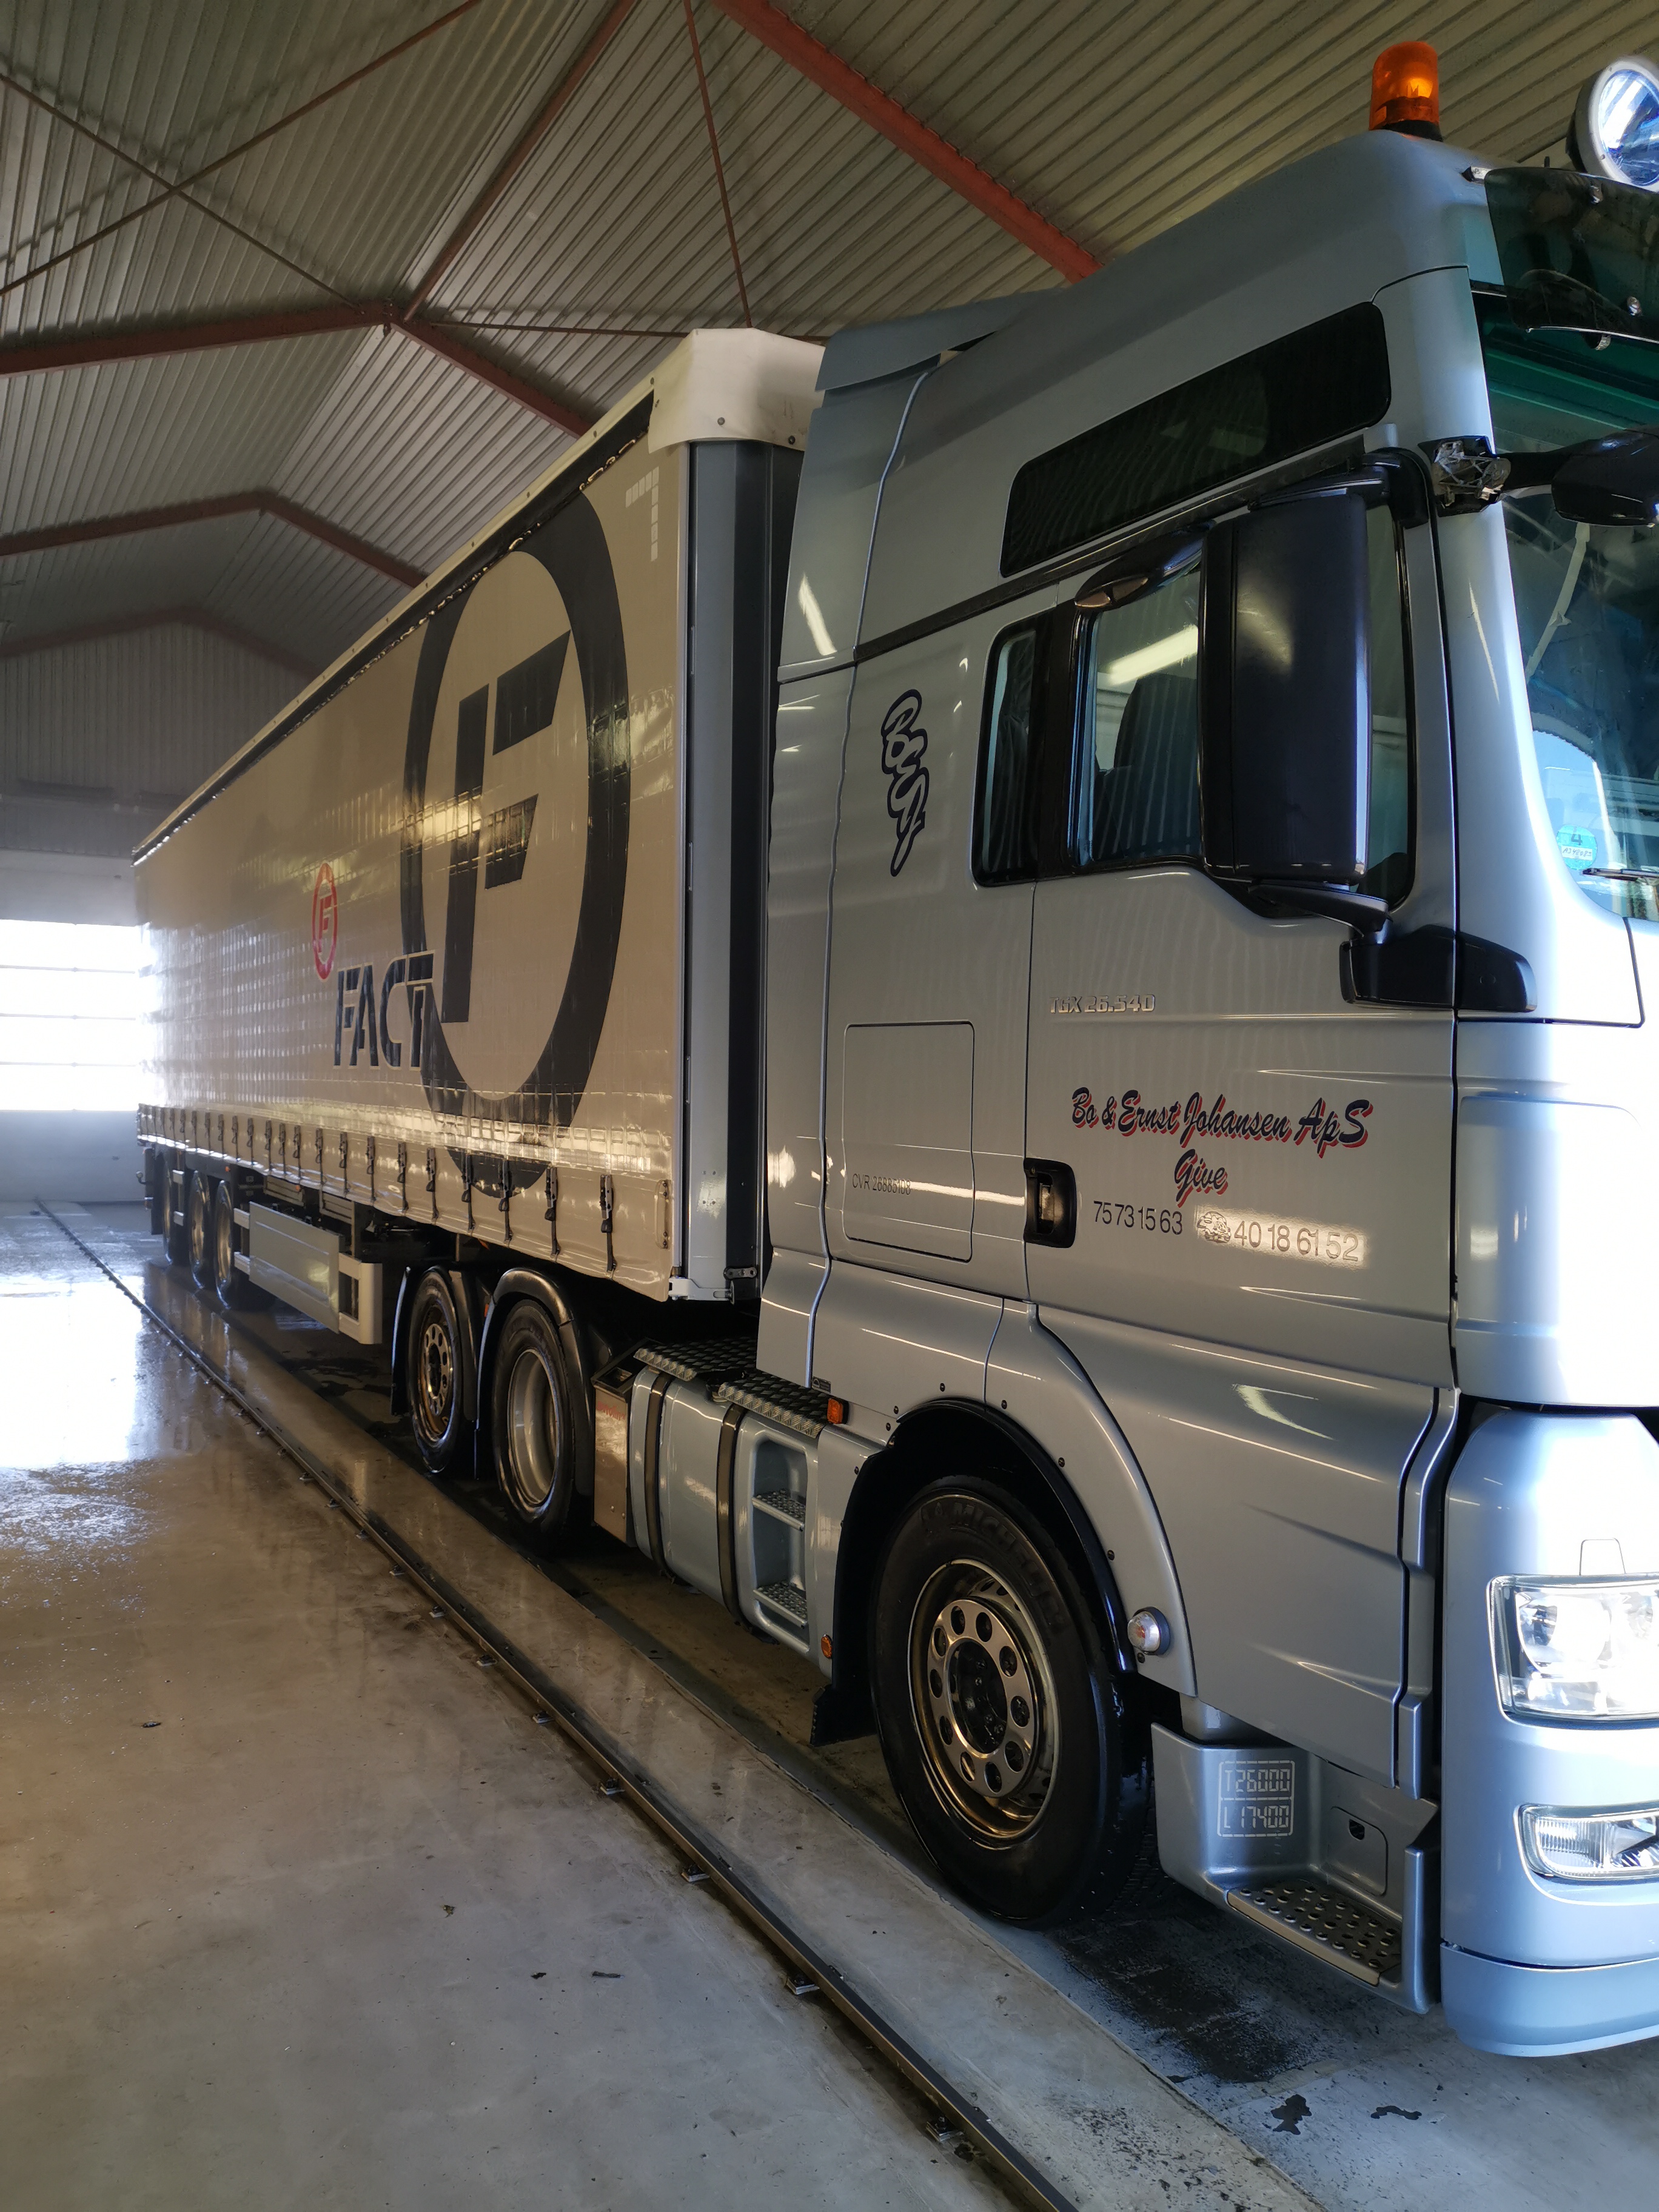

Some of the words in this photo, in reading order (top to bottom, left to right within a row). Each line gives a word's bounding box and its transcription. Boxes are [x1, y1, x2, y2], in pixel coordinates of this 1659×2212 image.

[333, 950, 435, 1071] FACT
[1050, 996, 1082, 1013] TGX
[1084, 994, 1156, 1013] 26.540
[1071, 1087, 1099, 1128] Bo
[1101, 1095, 1117, 1130] &
[1117, 1089, 1181, 1137] Ernst
[1179, 1091, 1296, 1148] Johansen
[1293, 1097, 1374, 1159] ApS
[852, 1173, 870, 1190] CVR
[1173, 1148, 1229, 1208] Give
